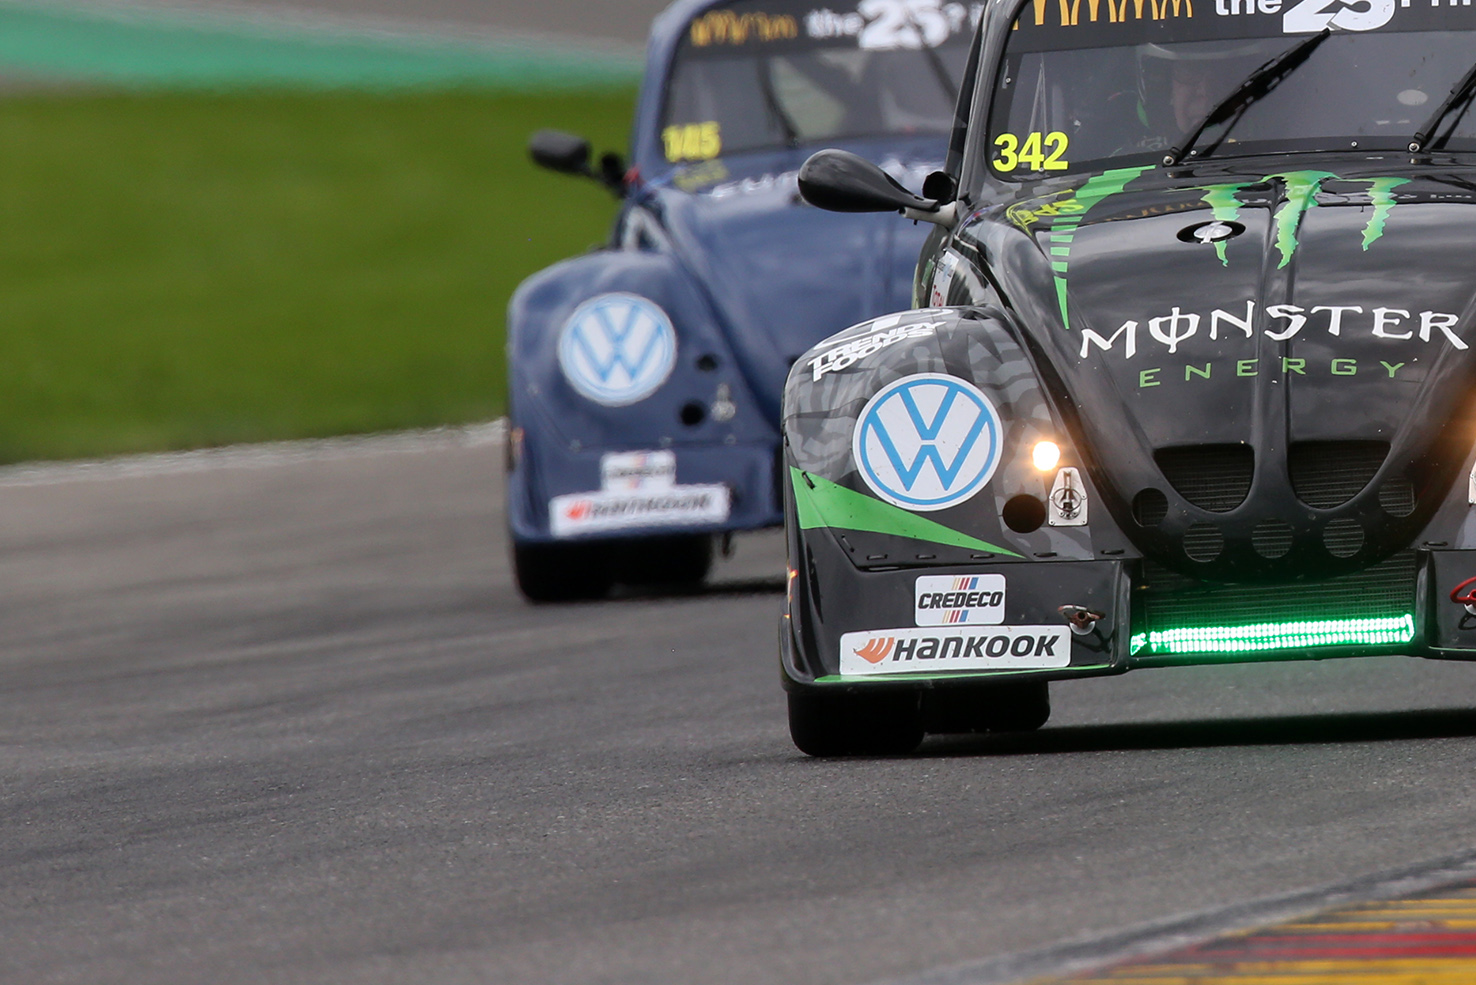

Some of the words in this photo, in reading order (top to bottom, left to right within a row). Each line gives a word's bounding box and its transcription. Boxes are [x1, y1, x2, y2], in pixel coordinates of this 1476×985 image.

[993, 131, 1069, 172] 342
[808, 321, 947, 366] TRENDY
[1079, 300, 1469, 359] MONSTER
[812, 329, 936, 382] FOODS
[1139, 358, 1404, 388] ENERGY
[918, 591, 1003, 609] CREDECO
